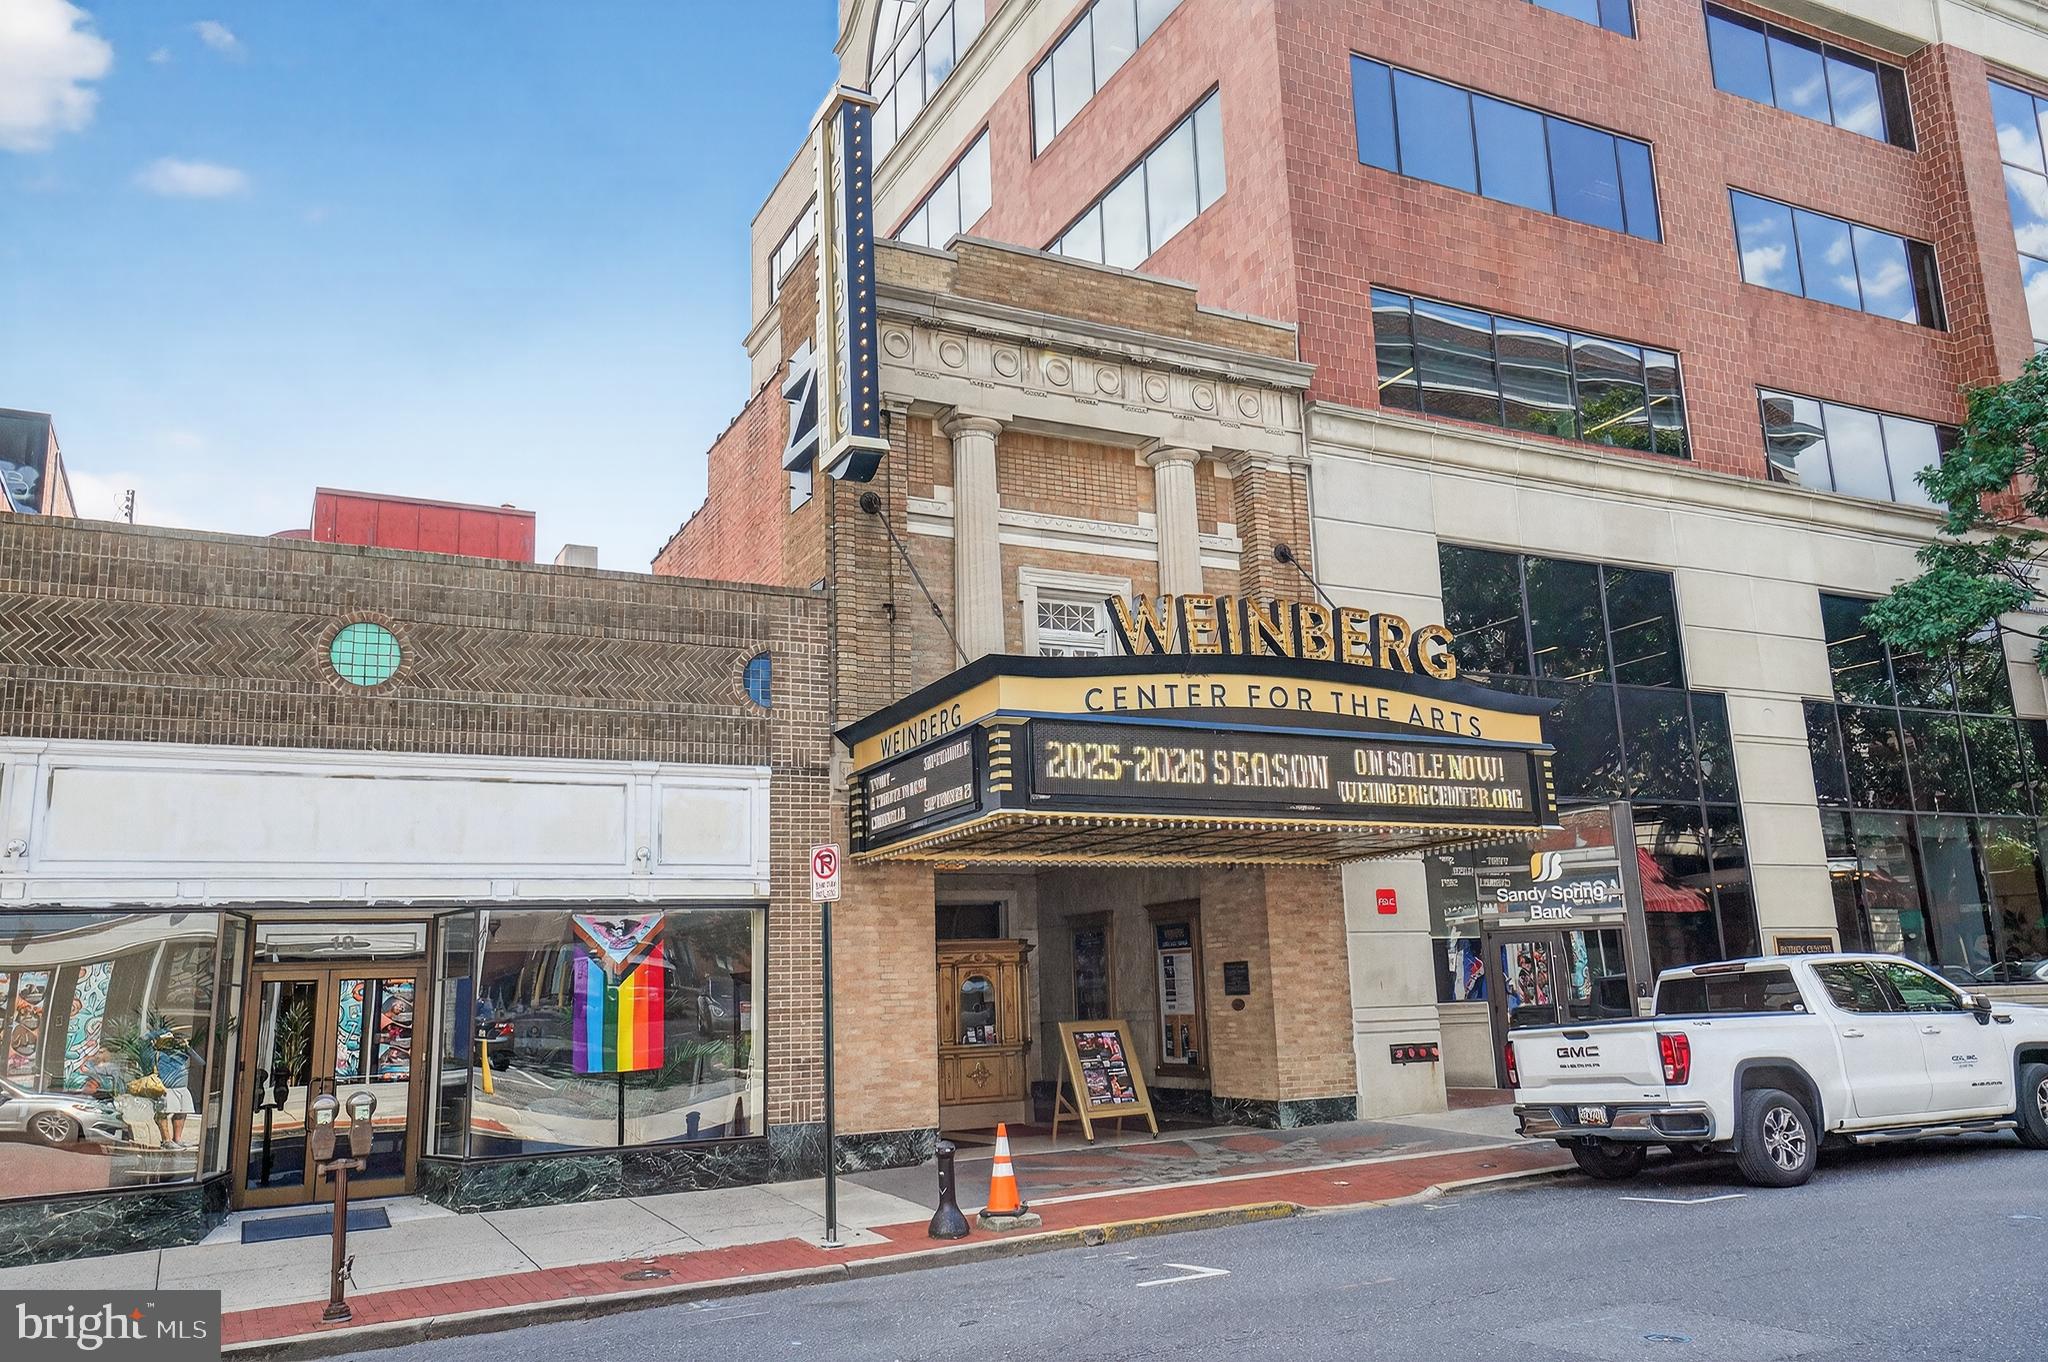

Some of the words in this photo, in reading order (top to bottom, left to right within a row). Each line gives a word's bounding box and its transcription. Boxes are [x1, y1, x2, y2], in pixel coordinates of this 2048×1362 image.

[1106, 592, 1457, 680] WEINBERG
[1085, 683, 1227, 712] CENTER
[1248, 685, 1313, 711] FOR
[1330, 691, 1390, 721] THE
[1408, 703, 1483, 738] ARTS
[880, 703, 962, 758] WEINBERG
[1046, 741, 1205, 784] 2025-2026
[1213, 750, 1329, 790] SEASON
[1354, 749, 1383, 776] ON
[1386, 751, 1445, 779] SALE
[1449, 755, 1504, 783] NOW!
[1337, 781, 1523, 809] WEINBERGCENTER.ORG
[1496, 886, 1548, 904] Sandy
[1550, 884, 1604, 902] Spring
[1530, 904, 1572, 919] Bank
[1557, 1046, 1600, 1058] GMC
